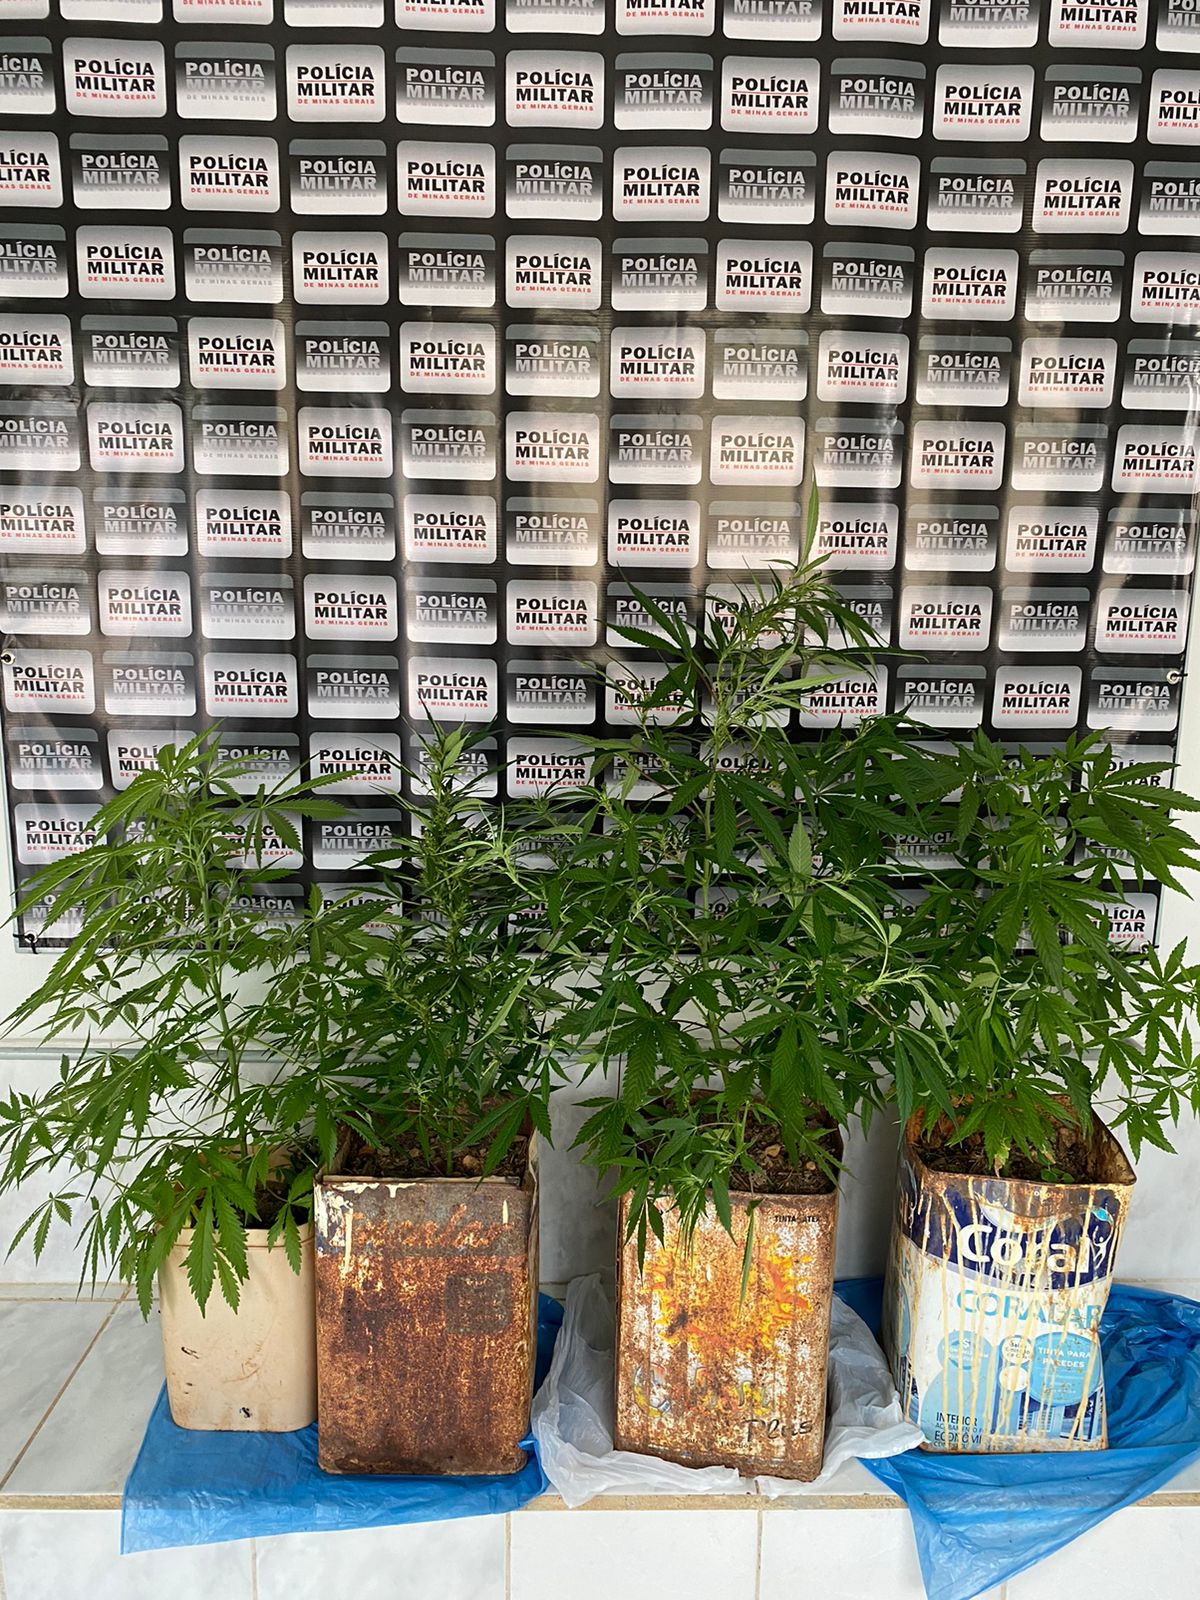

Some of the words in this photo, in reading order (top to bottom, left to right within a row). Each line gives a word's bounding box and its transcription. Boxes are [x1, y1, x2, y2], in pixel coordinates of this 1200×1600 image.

[74, 59, 155, 76] POLÍCIA
[297, 65, 375, 80] POLÍCIA
[75, 75, 155, 92] MILITAR
[406, 68, 485, 86] POLÍCIA
[516, 70, 594, 87] POLÍCIA
[625, 72, 702, 89] POLÍCIA
[732, 76, 809, 93] POLÍCIA
[297, 82, 375, 97] MILITAR
[406, 85, 485, 101] MILITAR
[840, 77, 915, 98] POLÍCIA
[945, 84, 1022, 100] POLÍCIA
[1054, 83, 1130, 103] POLÍCIA
[91, 92, 121, 100] MINAS
[516, 88, 594, 104] MILITAR
[625, 88, 702, 104] MILITAR
[731, 93, 809, 109] MILITAR
[840, 94, 915, 113] MILITAR
[944, 101, 1022, 116] MILITAR
[1053, 100, 1130, 117] MILITAR
[82, 153, 159, 169] POLÍCIA
[189, 154, 268, 172] POLÍCIA
[82, 169, 159, 184] MILITAR
[407, 161, 485, 178] POLÍCIA
[516, 163, 593, 180] POLÍCIA
[623, 166, 700, 181] POLÍCIA
[729, 167, 805, 184] POLÍCIA
[190, 172, 269, 188] MILITAR
[407, 177, 485, 193] MILITAR
[516, 180, 593, 195] MILITAR
[836, 172, 910, 189] POLÍCIA
[939, 176, 1014, 193] POLÍCIA
[1045, 178, 1122, 193] POLÍCIA
[623, 183, 700, 197] MILITAR
[728, 184, 805, 200] MILITAR
[835, 187, 909, 205] MILITAR
[938, 192, 1013, 209] MILITAR
[1044, 195, 1121, 209] MILITAR
[86, 244, 164, 260] POLÍCIA
[303, 250, 378, 265] POLÍCIA
[409, 251, 485, 270] POLÍCIA
[515, 254, 592, 270] POLÍCIA
[726, 258, 802, 274] POLÍCIA
[87, 261, 164, 276] MILITAR
[303, 267, 379, 281] MILITAR
[409, 268, 485, 283] MILITAR
[832, 261, 904, 279] POLÍCIA
[933, 266, 1007, 282] POLÍCIA
[515, 271, 592, 286] MILITAR
[726, 274, 802, 289] MILITAR
[832, 278, 904, 294] MILITAR
[932, 282, 1007, 297] MILITAR
[92, 333, 168, 350] POLÍCIA
[198, 336, 275, 352] POLÍCIA
[306, 338, 380, 355] POLÍCIA
[409, 340, 485, 356] POLÍCIA
[92, 349, 169, 365] MILITAR
[516, 342, 590, 359] POLÍCIA
[620, 345, 695, 360] POLÍCIA
[828, 349, 899, 366] POLÍCIA
[199, 352, 275, 367] MILITAR
[305, 355, 380, 369] MILITAR
[410, 356, 485, 371] MILITAR
[516, 358, 590, 373] MILITAR
[620, 362, 695, 375] MILITAR
[827, 365, 899, 381] MILITAR
[308, 425, 382, 440] POLÍCIA
[411, 427, 486, 444] POLÍCIA
[619, 431, 692, 447] POLÍCIA
[309, 441, 382, 455] MILITAR
[411, 442, 486, 458] MILITAR
[922, 438, 995, 453] POLÍCIA
[618, 448, 693, 462] MILITAR
[921, 454, 994, 468] MILITAR
[206, 507, 281, 522] POLÍCIA
[311, 509, 385, 526] POLÍCIA
[413, 512, 486, 527] POLÍCIA
[206, 522, 281, 536] MILITAR
[617, 514, 690, 531] POLÍCIA
[311, 524, 385, 539] MILITAR
[414, 527, 487, 541] MILITAR
[617, 532, 690, 546] MILITAR
[108, 587, 180, 601] POLÍCIA
[314, 591, 387, 606] POLÍCIA
[109, 602, 181, 615] MILITAR
[516, 597, 588, 611] POLÍCIA
[1010, 602, 1079, 619] POLÍCIA
[314, 606, 388, 620] MILITAR
[516, 612, 588, 625] MILITAR
[1107, 605, 1178, 619] POLÍCIA
[1009, 617, 1079, 631] MILITAR
[1106, 619, 1178, 633] MILITAR
[213, 669, 287, 683] POLÍCIA
[316, 670, 390, 686] POLÍCIA
[515, 676, 587, 691] POLÍCIA
[214, 684, 288, 697] MILITAR
[316, 685, 390, 699] MILITAR
[1003, 682, 1071, 695] POLÍCIA
[515, 690, 587, 704] MILITAR
[1002, 696, 1070, 708] MILITAR
[19, 742, 91, 758] POLÍCIA
[19, 756, 92, 771] MILITAR
[959, 1223, 1090, 1274] Coral
